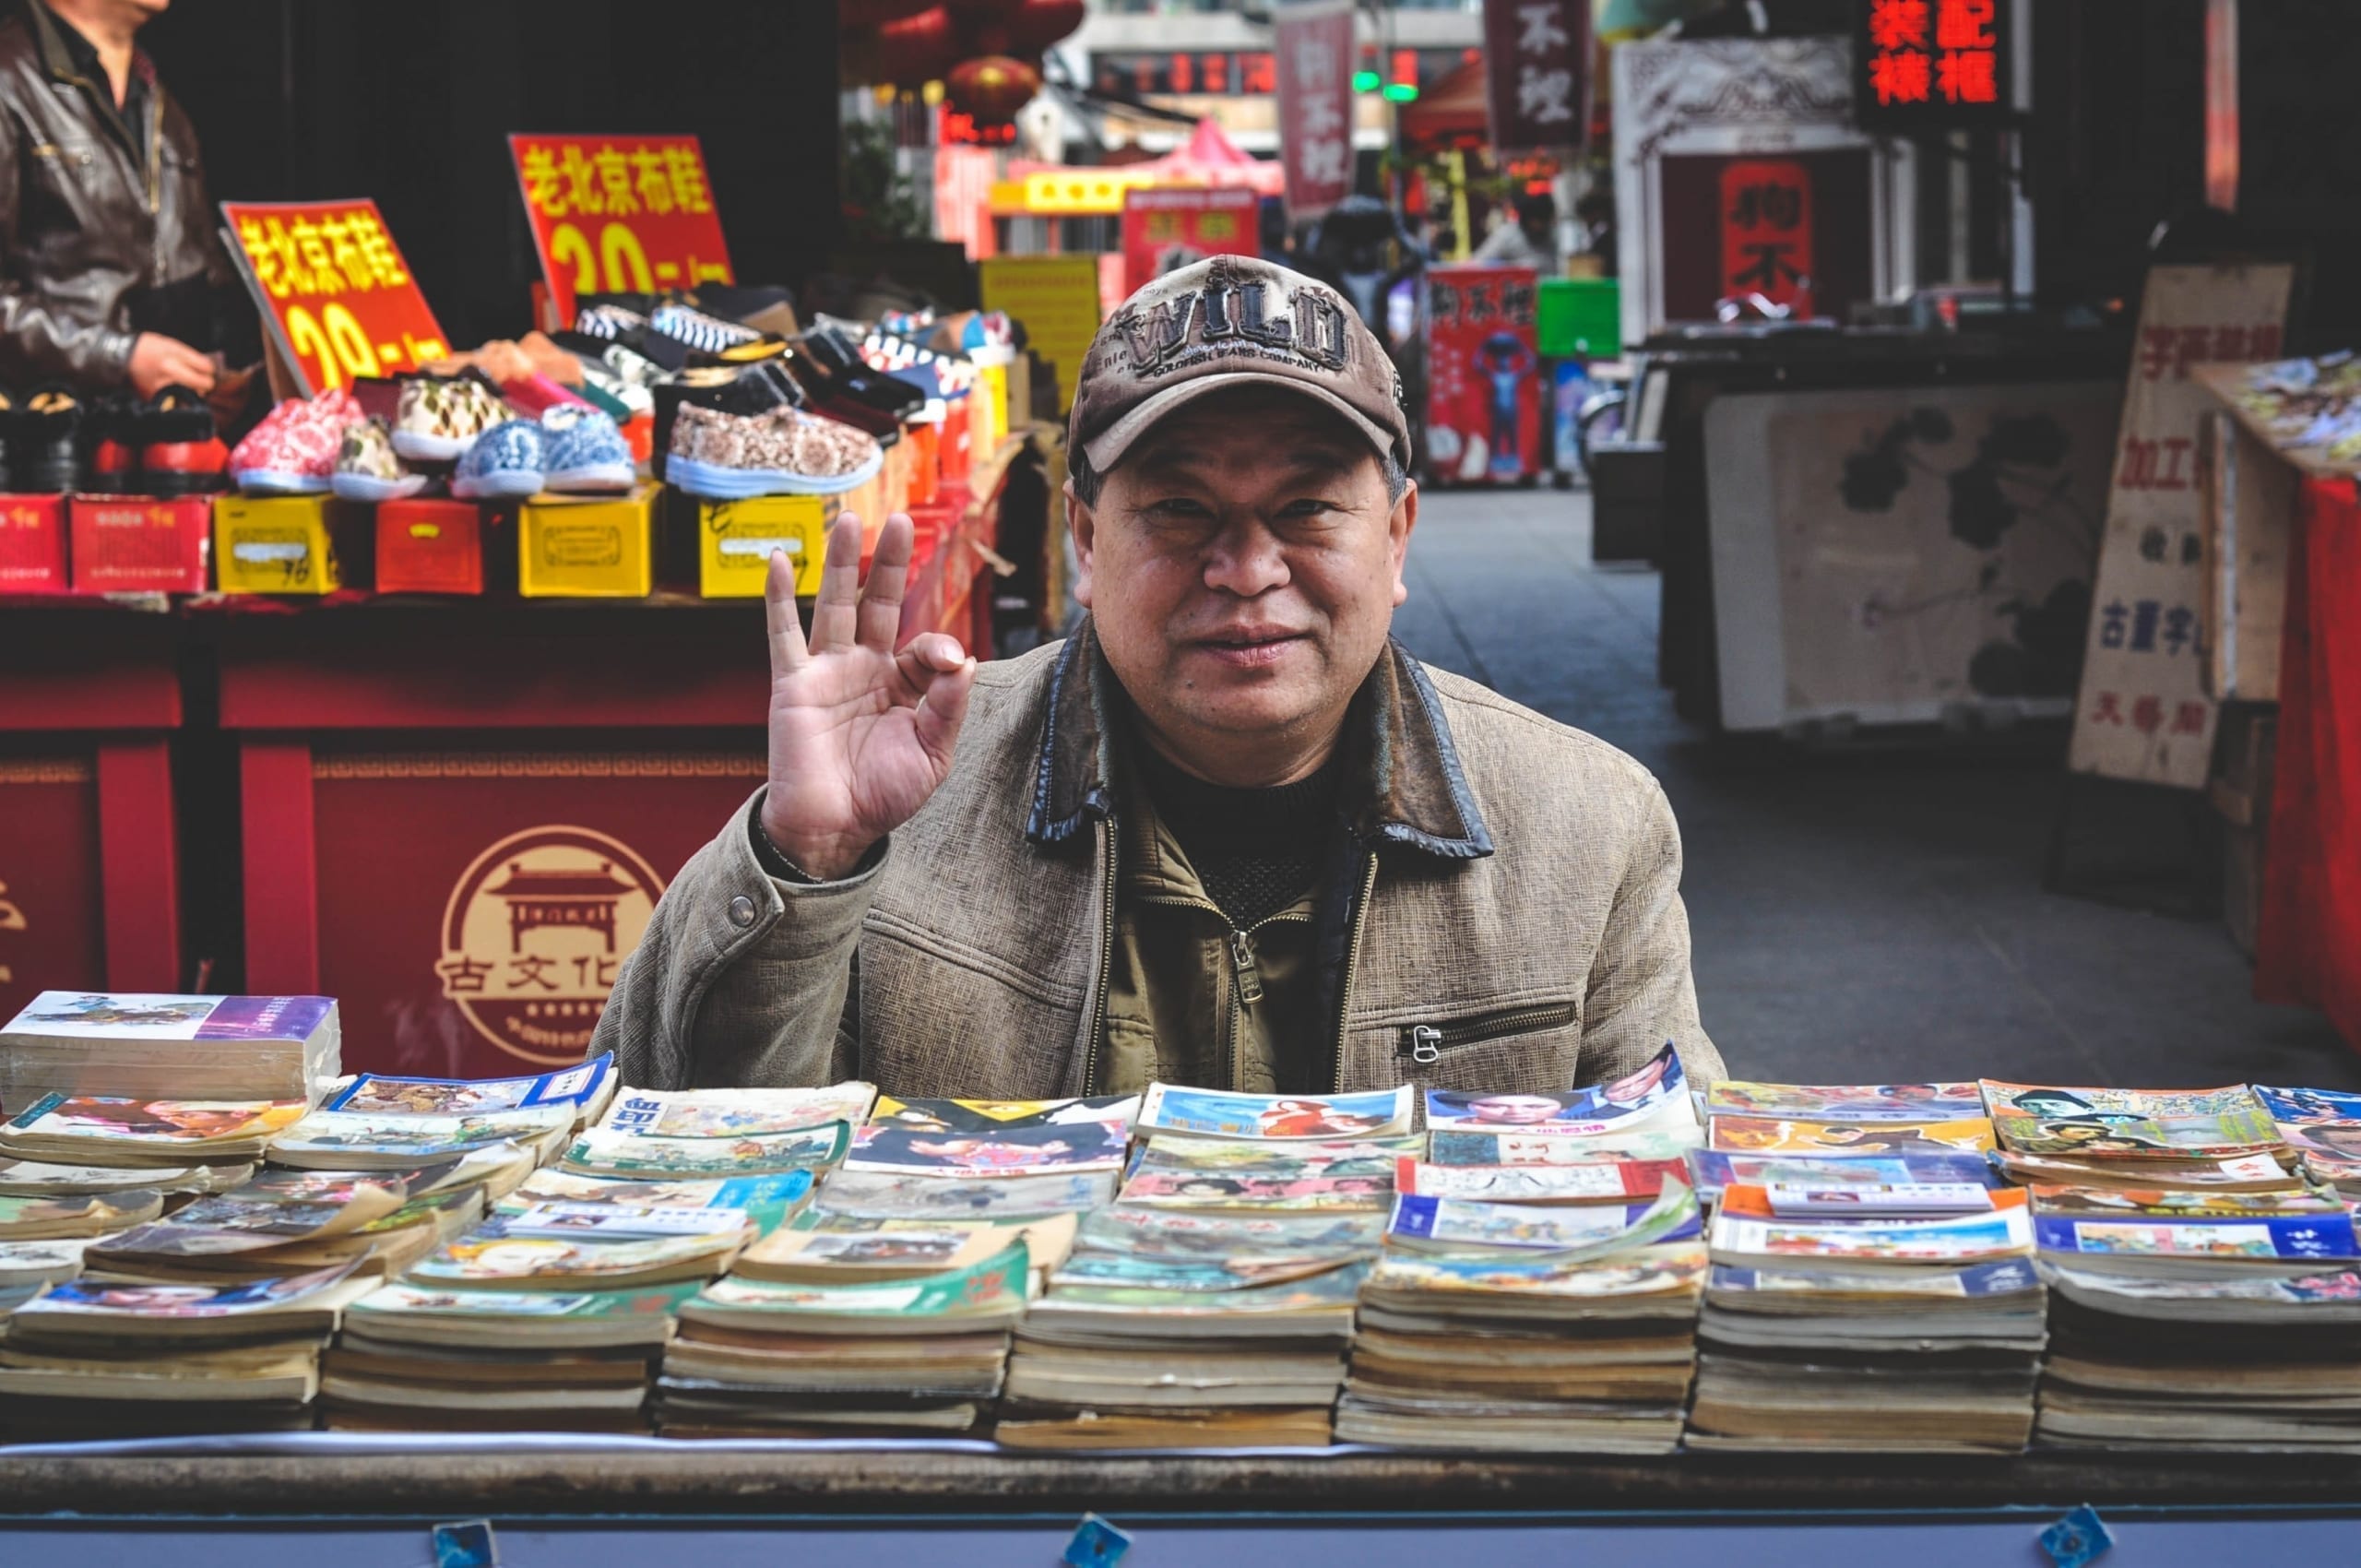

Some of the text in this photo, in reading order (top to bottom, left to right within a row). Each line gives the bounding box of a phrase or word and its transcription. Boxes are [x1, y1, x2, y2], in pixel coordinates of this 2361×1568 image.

[522, 144, 711, 217] 老北京布鞋
[238, 210, 409, 298] 老北京布鞋
